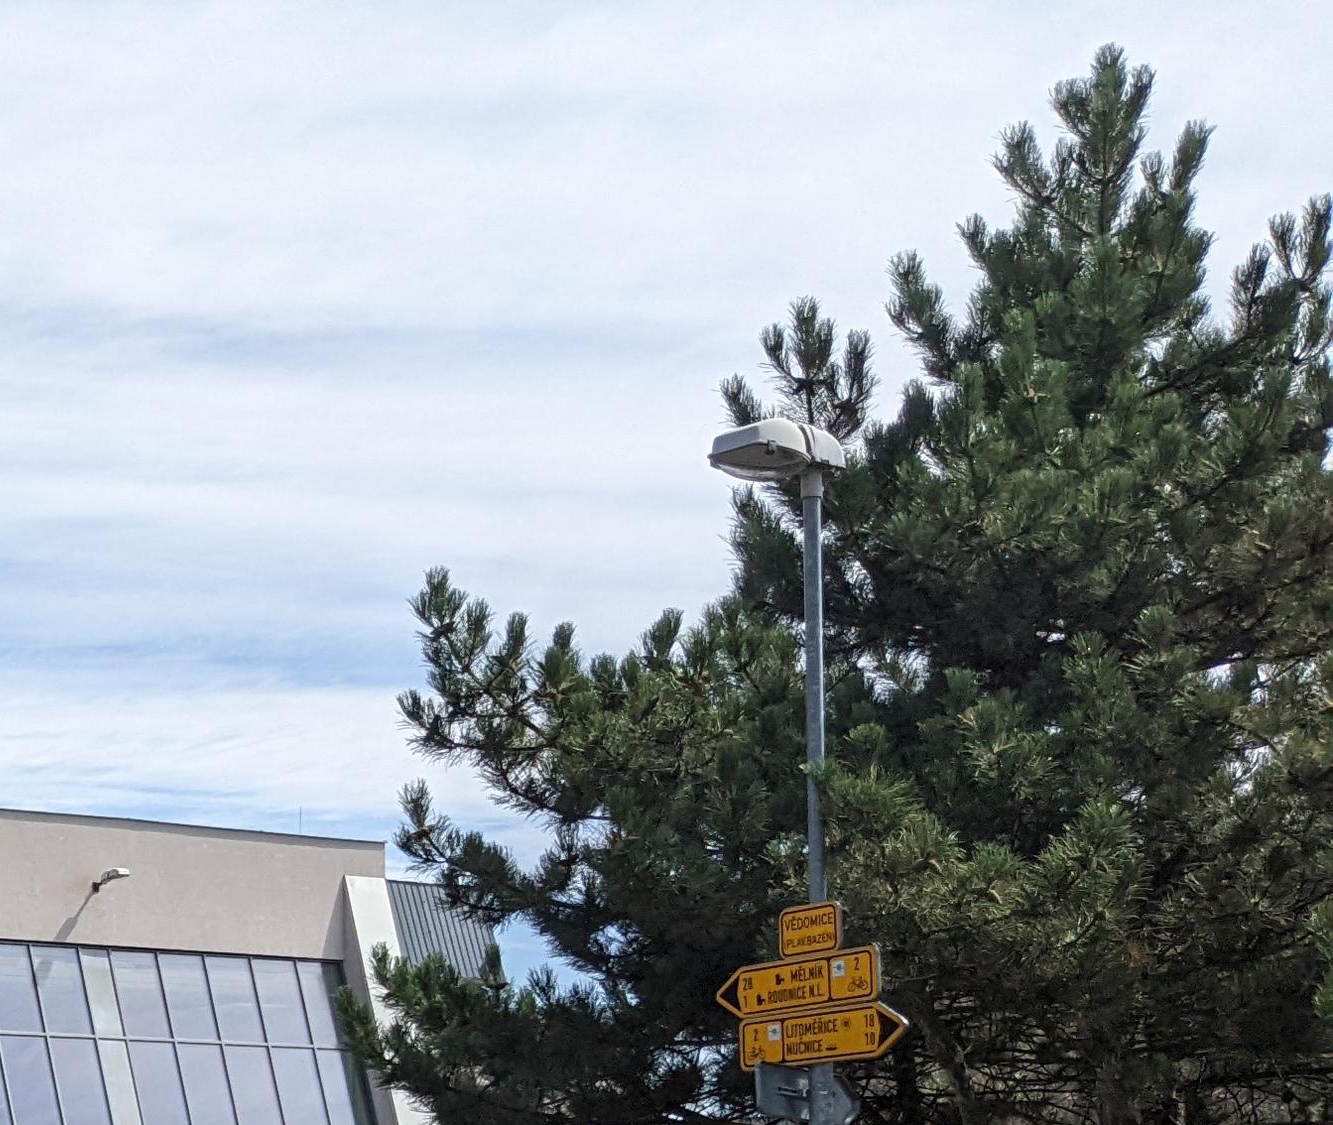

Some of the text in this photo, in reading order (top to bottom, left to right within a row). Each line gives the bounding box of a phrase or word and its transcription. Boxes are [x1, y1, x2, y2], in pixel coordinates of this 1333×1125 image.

[784, 912, 834, 931] VĚDOMICE
[854, 957, 860, 970] 2
[790, 964, 824, 983] MĚLNÍK
[768, 986, 807, 1004] ROUDNICE
[786, 1017, 838, 1038] LITOMĚŘICE
[786, 1038, 823, 1057] NUČNICE
